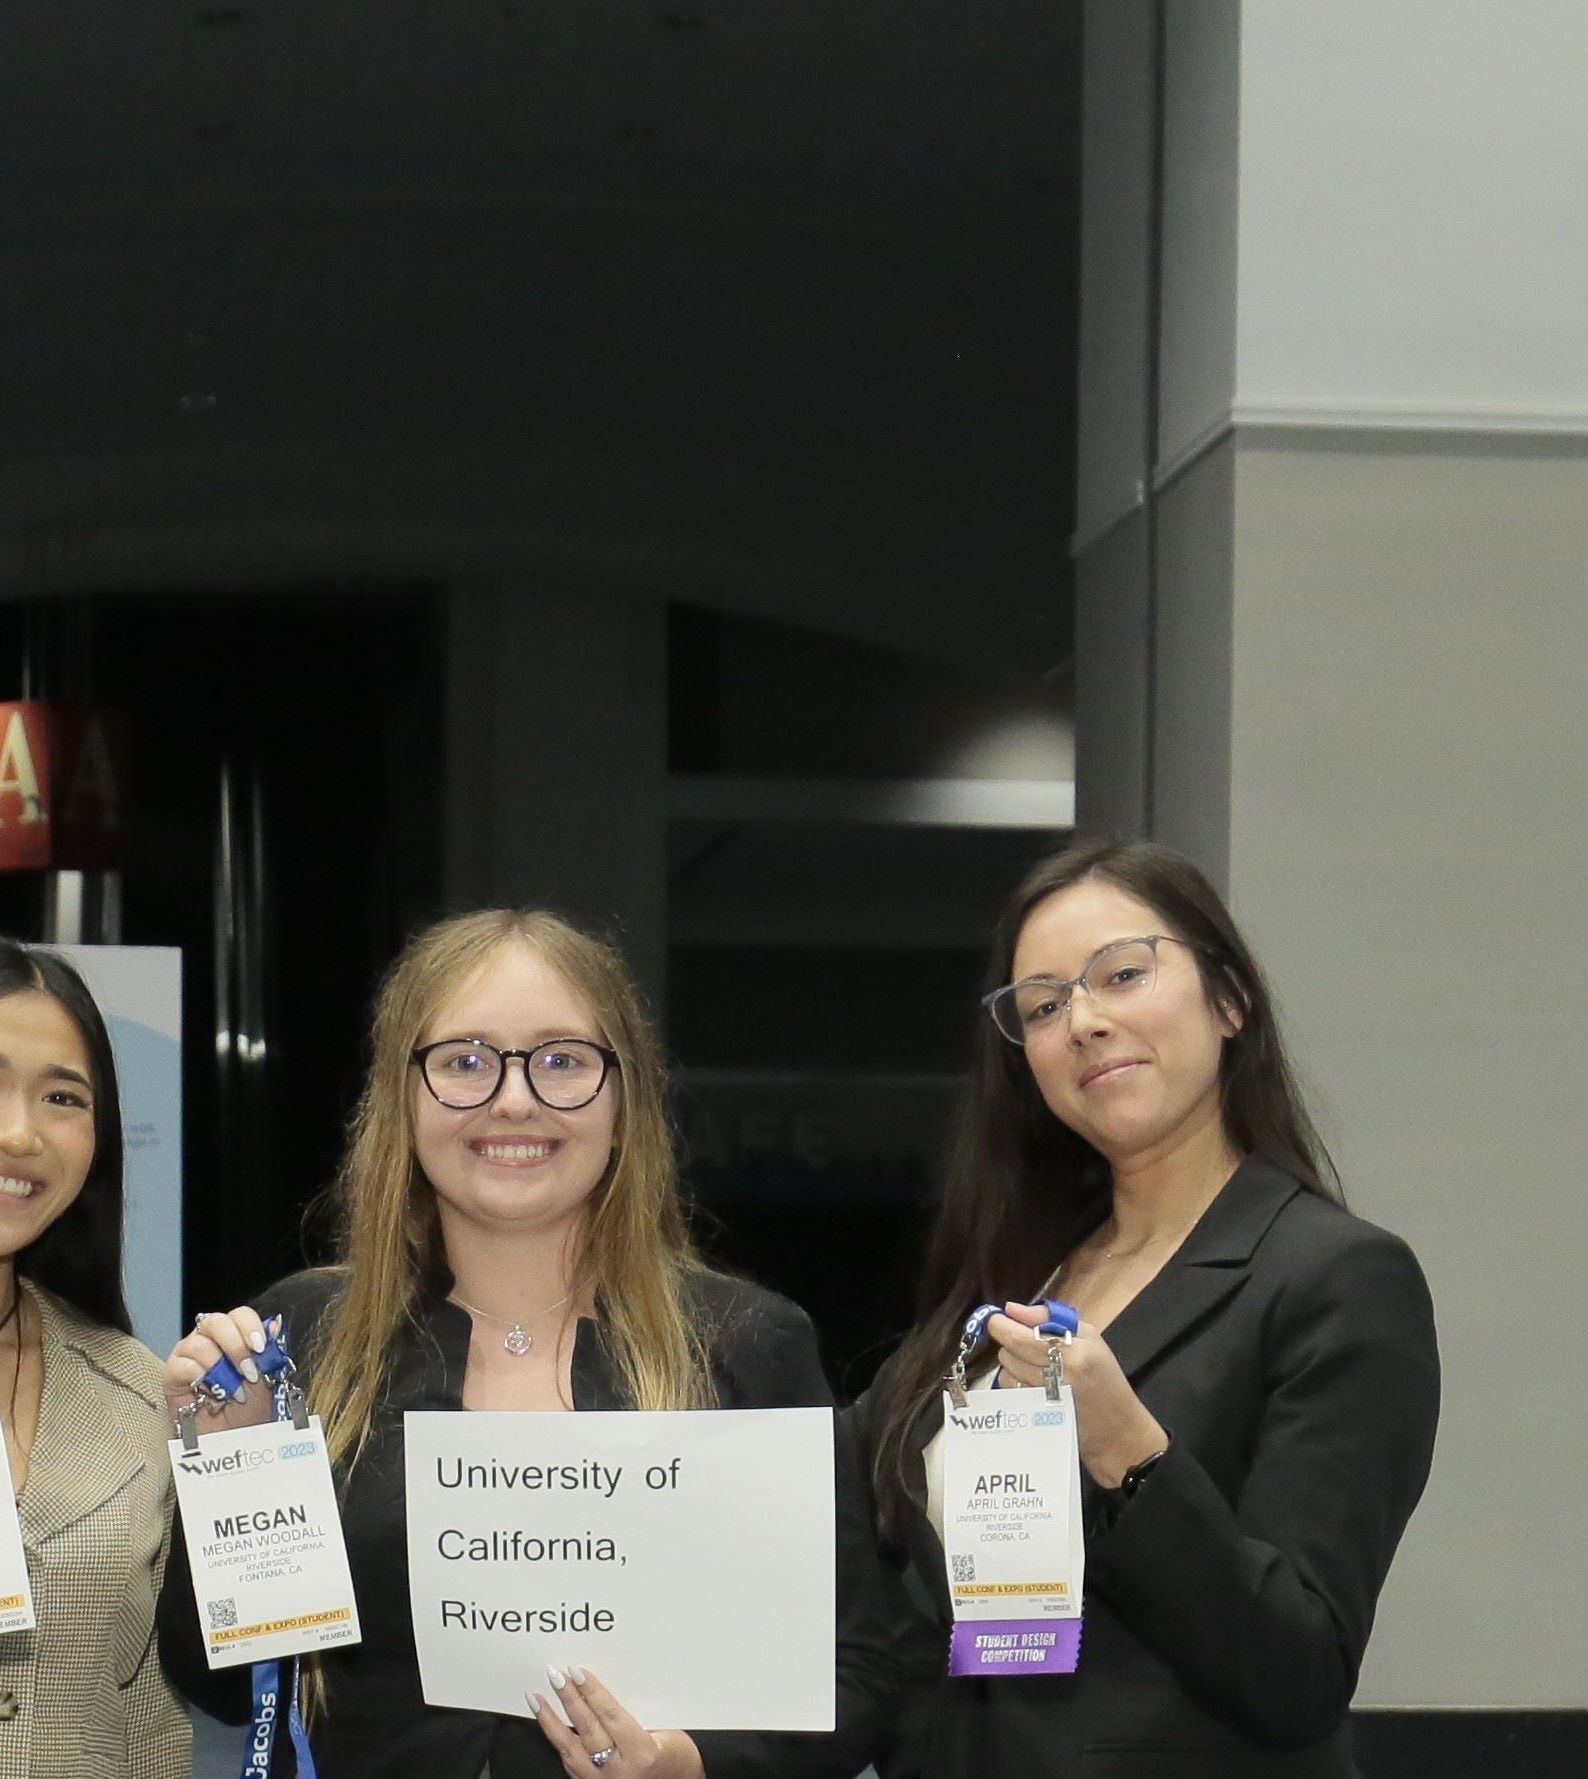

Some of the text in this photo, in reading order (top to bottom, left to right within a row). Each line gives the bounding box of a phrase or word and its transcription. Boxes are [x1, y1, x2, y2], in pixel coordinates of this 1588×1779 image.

[1034, 1411, 1063, 1426] 2023
[281, 1442, 315, 1459] 2023
[435, 1456, 682, 1498] University of
[974, 1473, 1036, 1494] APRIL
[967, 1496, 1043, 1510] APRIL GRAHN
[213, 1504, 307, 1539] MEGAN
[202, 1525, 327, 1557] MEGAN WOODALL
[1019, 1532, 1030, 1541] CA
[207, 1553, 257, 1569] UNIVERSITY
[273, 1541, 326, 1556] CALIFORNIA
[437, 1529, 628, 1566] California,
[246, 1557, 291, 1571] RIVERSIDE
[289, 1565, 303, 1575] CA
[440, 1600, 616, 1633] Riverside
[215, 1631, 236, 1641] FULL
[239, 1627, 261, 1636] CONF
[274, 1619, 297, 1630] EXPO
[975, 1632, 1056, 1648] STUDENT DESIGN
[981, 1648, 1046, 1663] COMPETITION
